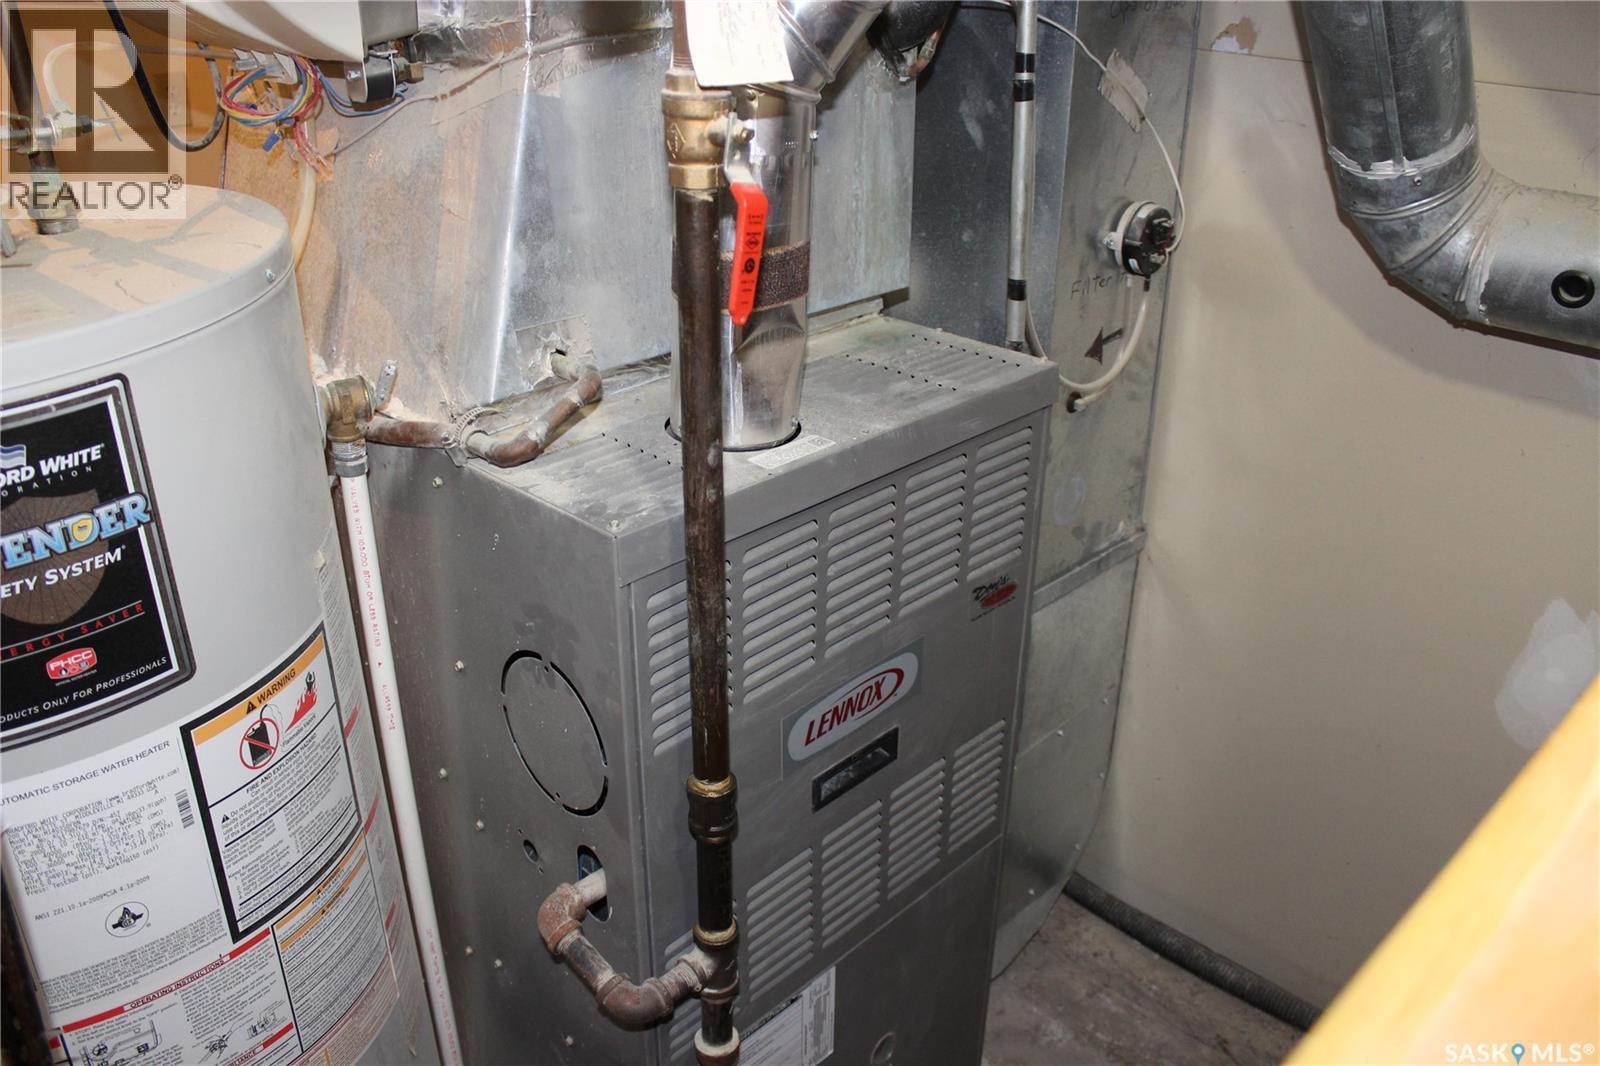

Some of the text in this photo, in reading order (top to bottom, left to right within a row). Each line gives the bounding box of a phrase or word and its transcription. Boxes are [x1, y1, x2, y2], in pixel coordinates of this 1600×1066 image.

[1070, 272, 1113, 300] Filter
[1, 493, 151, 570] ENDER
[0, 576, 37, 599] ETY
[0, 603, 144, 659] ERGY SAVER
[42, 696, 69, 711] ONLY
[72, 687, 93, 701] FOR
[96, 656, 167, 692] PROFESSIONALS
[49, 649, 94, 671] PHCC
[255, 668, 298, 703] WARNING
[804, 676, 888, 747] LENNOX
[52, 769, 99, 791] STORAGE
[100, 755, 135, 775] WATER
[136, 740, 171, 761] HEATER
[246, 781, 258, 793] FIRE
[259, 772, 272, 783] AND
[130, 958, 225, 1009] OPERATING INSTRUCTIONS
